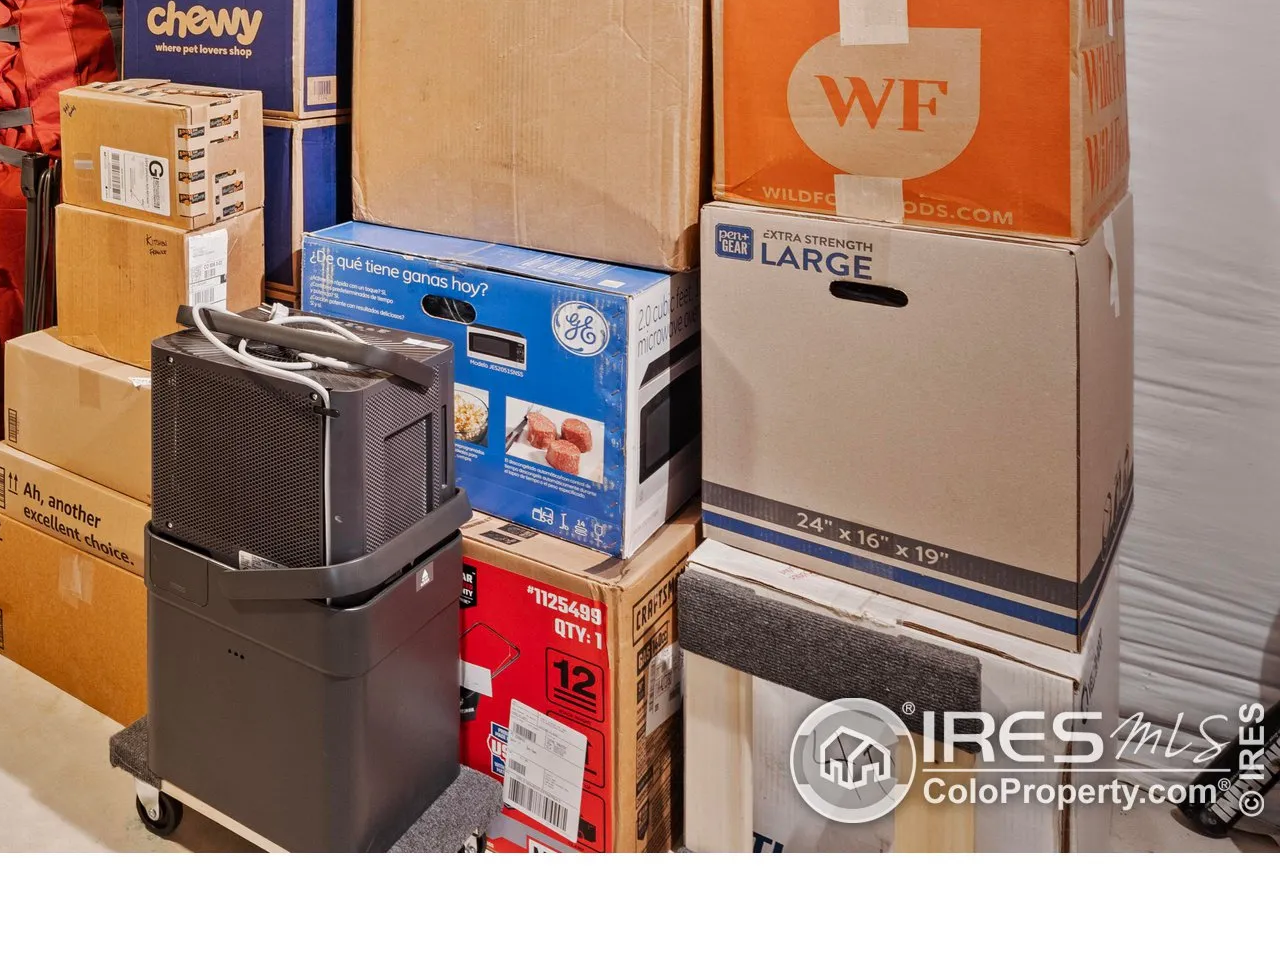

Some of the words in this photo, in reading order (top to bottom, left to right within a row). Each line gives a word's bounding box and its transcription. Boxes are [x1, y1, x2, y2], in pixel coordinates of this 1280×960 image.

[147, 0, 263, 45] chewy
[155, 43, 181, 53] where
[182, 44, 198, 55] pet
[199, 45, 228, 55] lovers
[229, 46, 252, 59] shop
[814, 74, 948, 132] WF
[762, 186, 1014, 225] WILDFOODS.COM
[722, 241, 748, 255] GEAR
[761, 242, 873, 281] LARGE
[805, 235, 873, 253] STRENGTH
[309, 250, 334, 265] ¿De
[336, 257, 362, 271] qué
[365, 260, 400, 279] tiene
[402, 270, 448, 289] ganas
[451, 275, 489, 298] hoy?
[637, 316, 683, 358] microwave
[23, 482, 45, 503] Ah,
[48, 493, 101, 529] another
[23, 506, 81, 542] excellent
[84, 534, 135, 566] choice.
[796, 511, 833, 533] 24"
[839, 526, 852, 540] x
[857, 529, 889, 548] 16"
[896, 544, 909, 558] x
[915, 545, 950, 565] 19"
[527, 584, 602, 627] #1125499
[636, 565, 686, 632] CRAFTSM
[554, 618, 591, 645] QTY:
[594, 631, 603, 650] 1
[553, 658, 597, 699] 12
